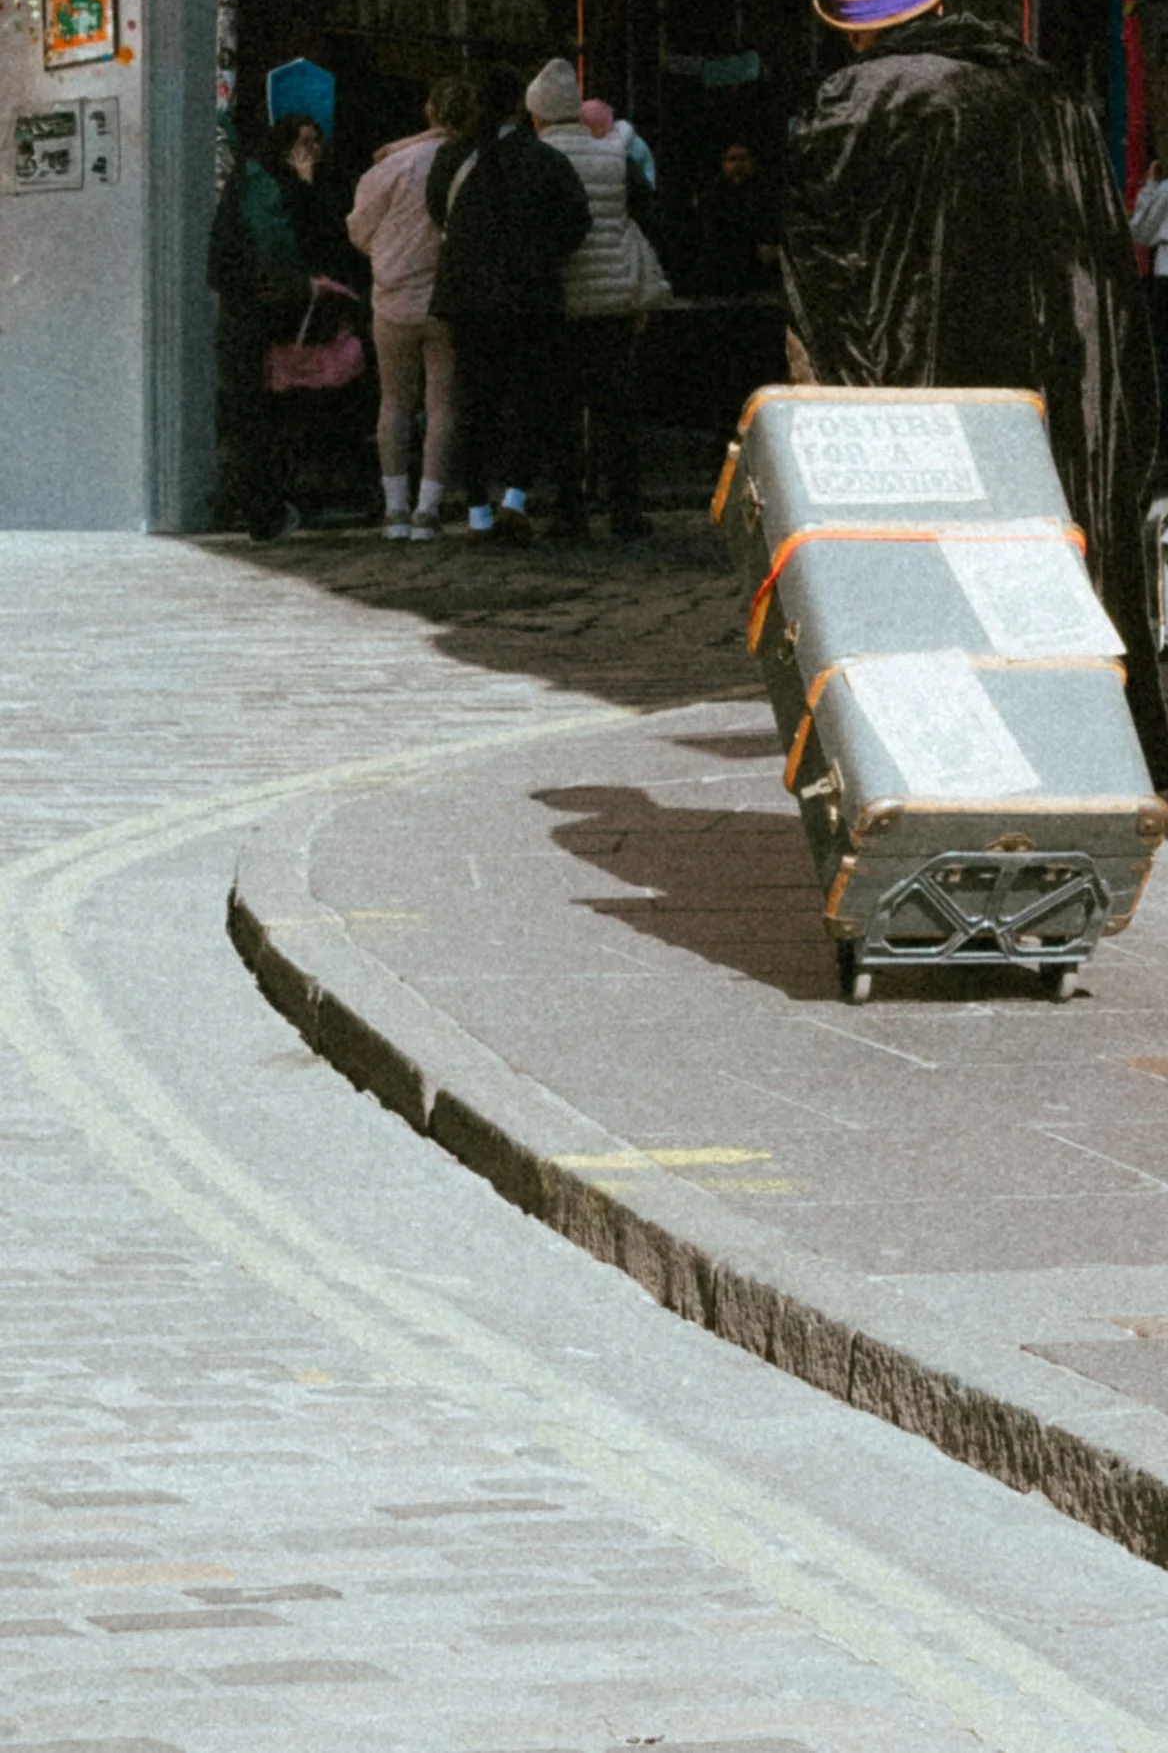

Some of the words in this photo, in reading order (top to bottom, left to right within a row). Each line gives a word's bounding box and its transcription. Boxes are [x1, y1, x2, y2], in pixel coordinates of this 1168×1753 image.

[796, 414, 955, 438] POSTERS
[803, 442, 868, 465] FOR
[889, 442, 914, 465] A
